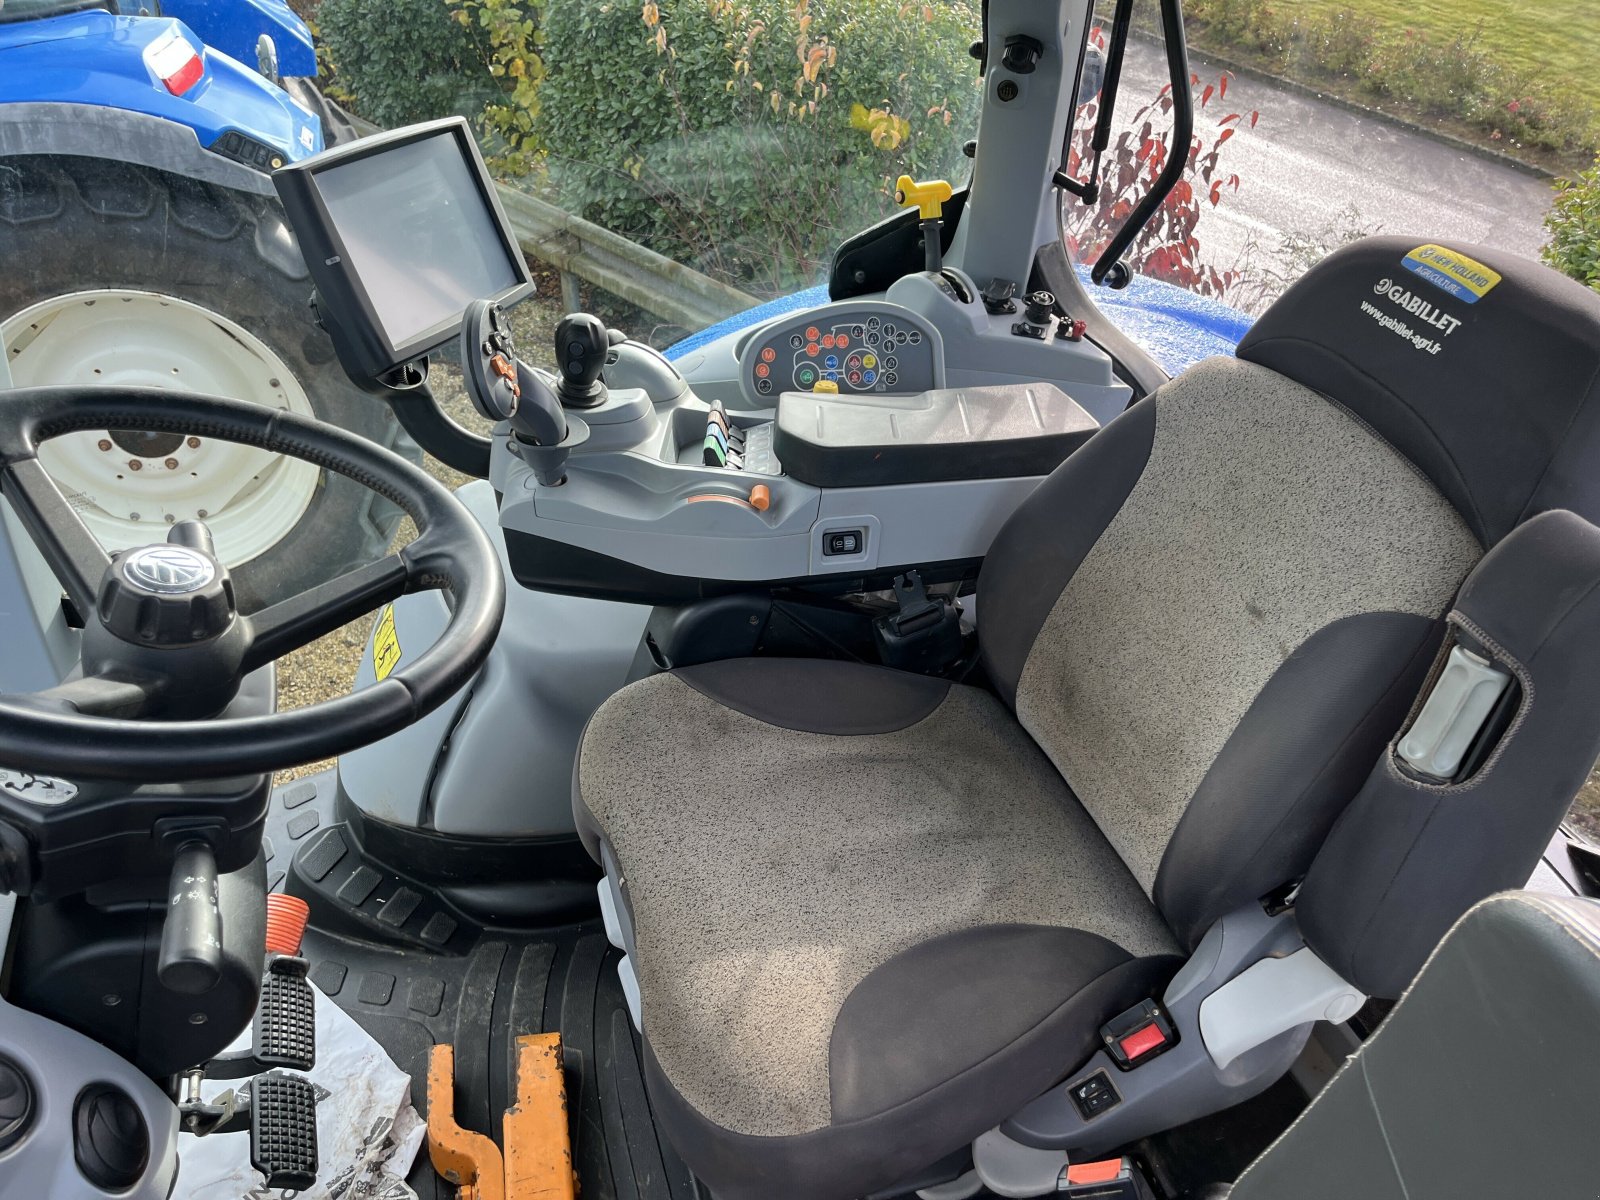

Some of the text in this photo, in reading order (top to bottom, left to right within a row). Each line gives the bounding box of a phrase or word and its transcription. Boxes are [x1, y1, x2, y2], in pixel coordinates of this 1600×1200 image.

[1414, 265, 1461, 295] AGRICULTURE
[1432, 254, 1489, 288] NEW HOLLAND
[1360, 300, 1442, 355] www.gabillet-agri.fr
[1387, 285, 1462, 337] GABILLET
